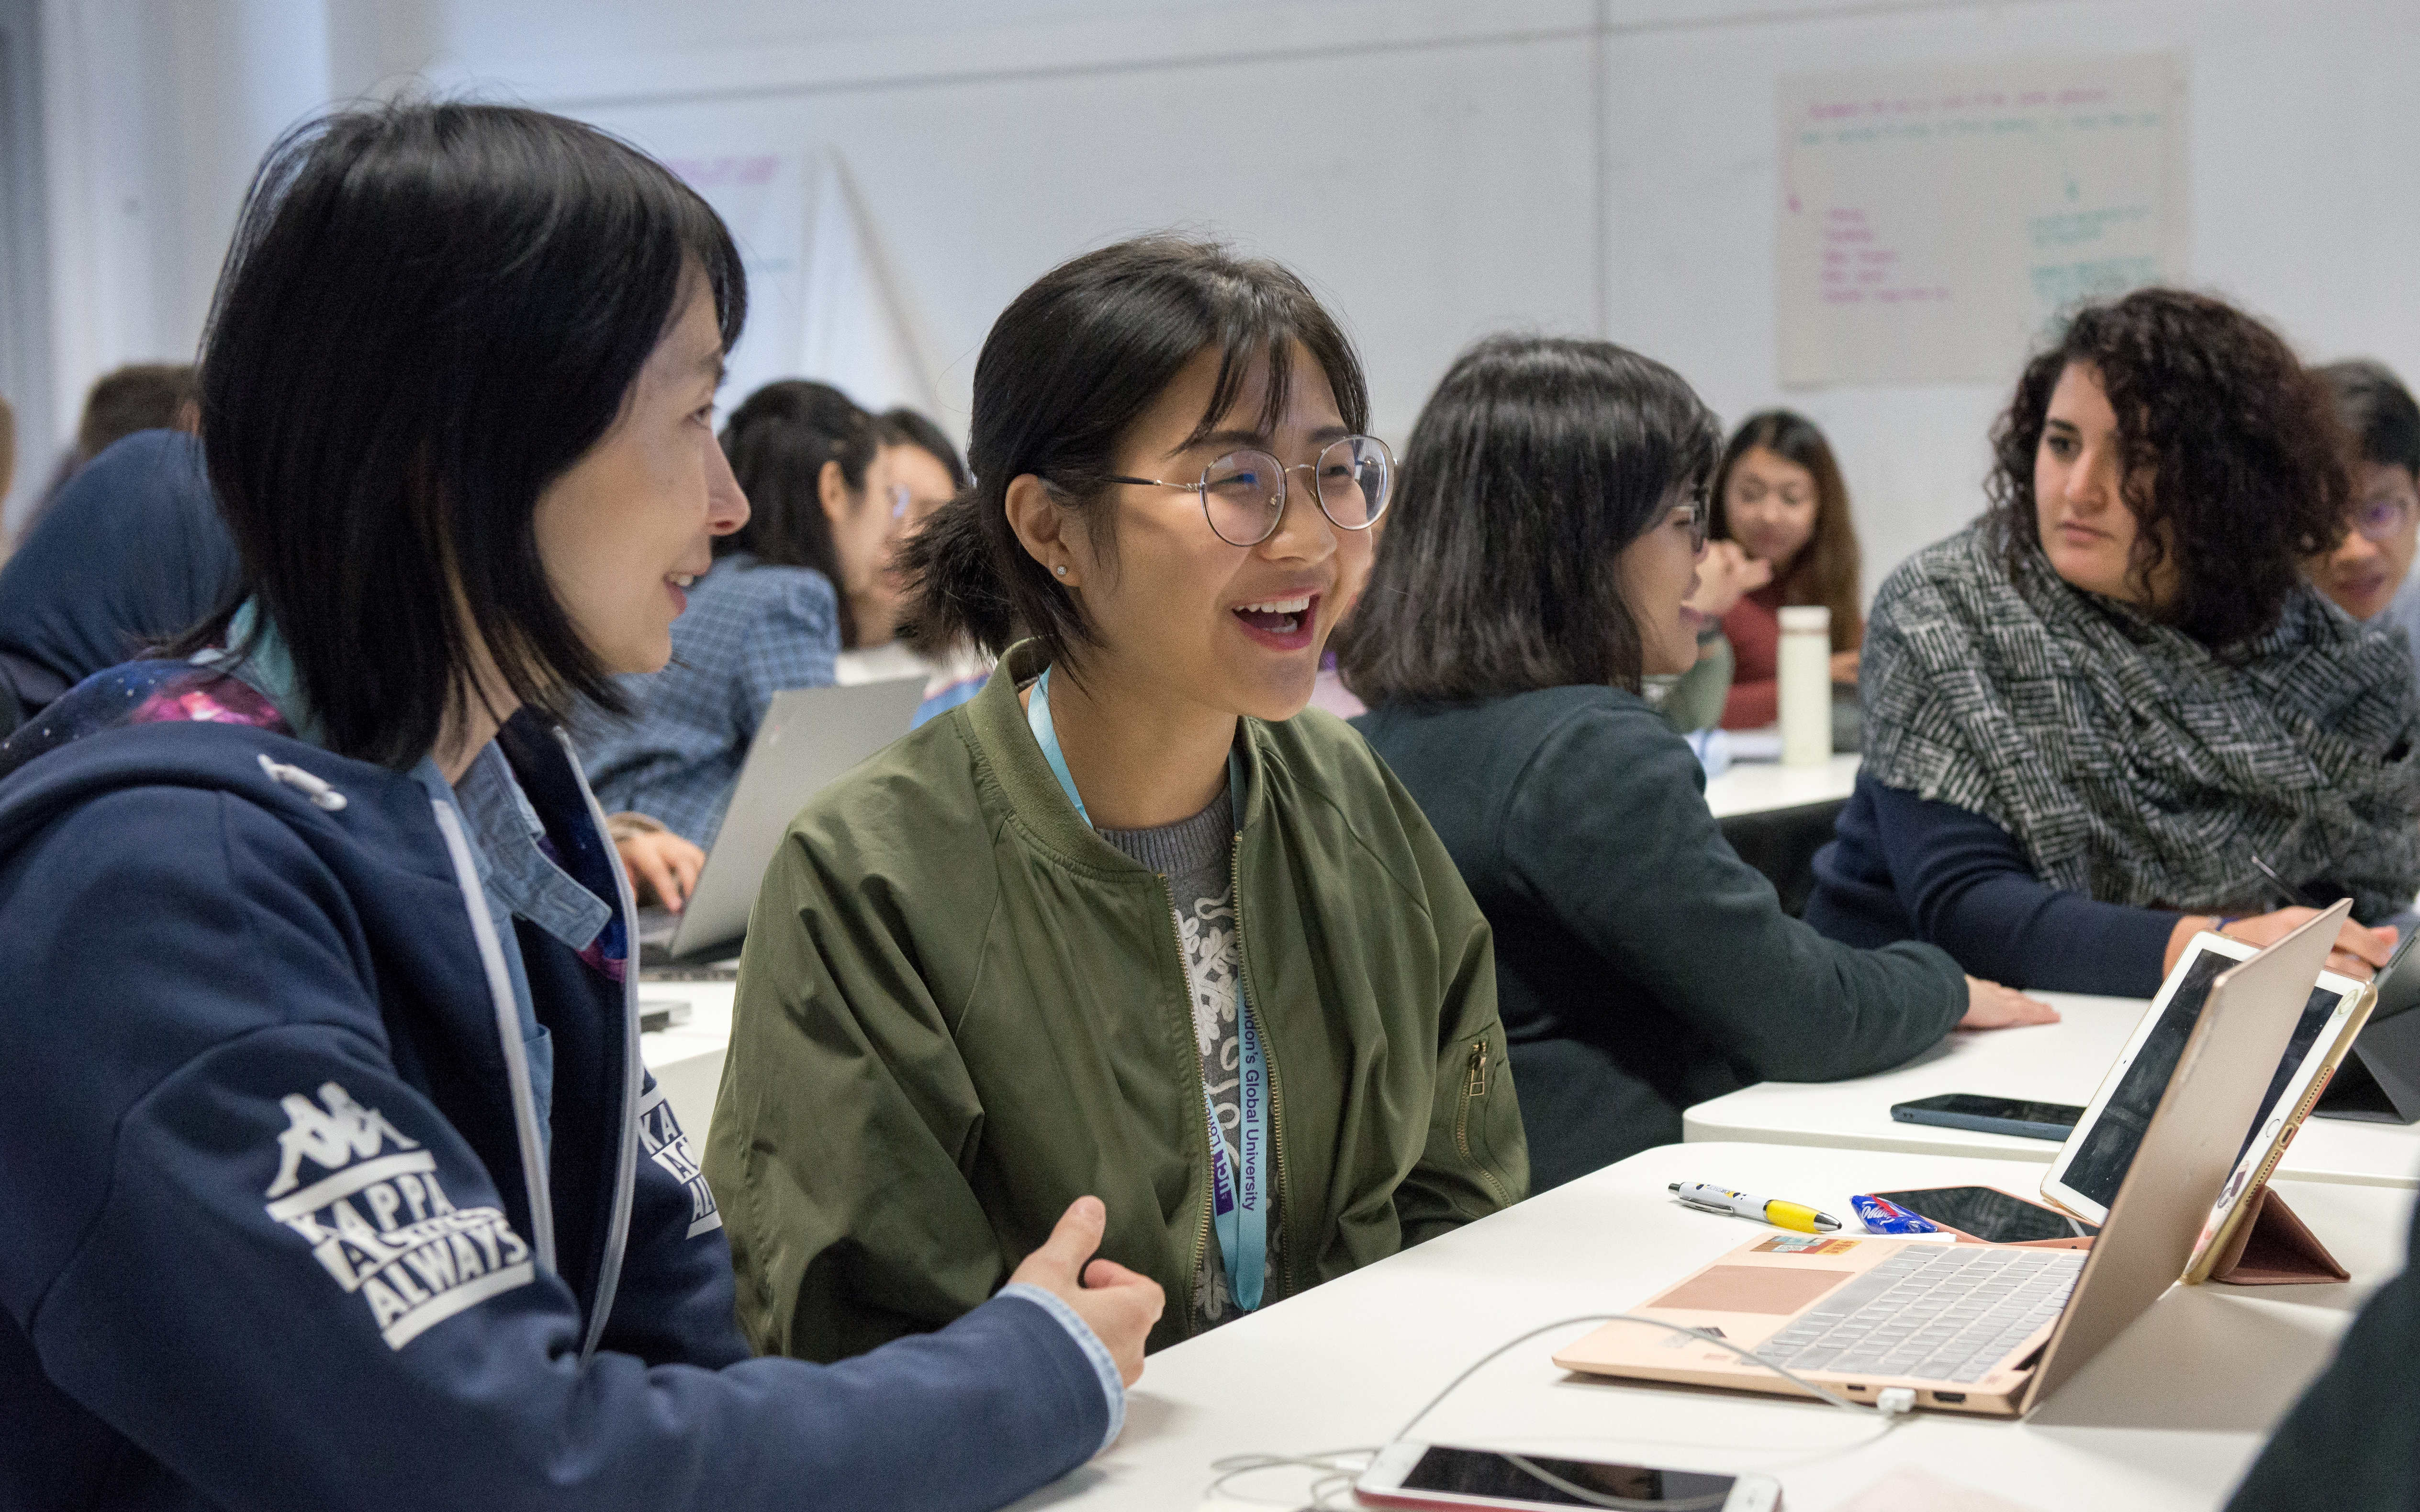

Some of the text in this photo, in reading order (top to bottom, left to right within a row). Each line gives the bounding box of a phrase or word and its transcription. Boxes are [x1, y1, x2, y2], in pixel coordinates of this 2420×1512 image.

[1245, 1069, 1259, 1123] Global
[640, 1103, 679, 1155] KA
[1215, 1152, 1231, 1195] UCL
[1242, 1128, 1259, 1212] University
[287, 1172, 458, 1244] KAPPA
[362, 1219, 528, 1328] ALWAYS
